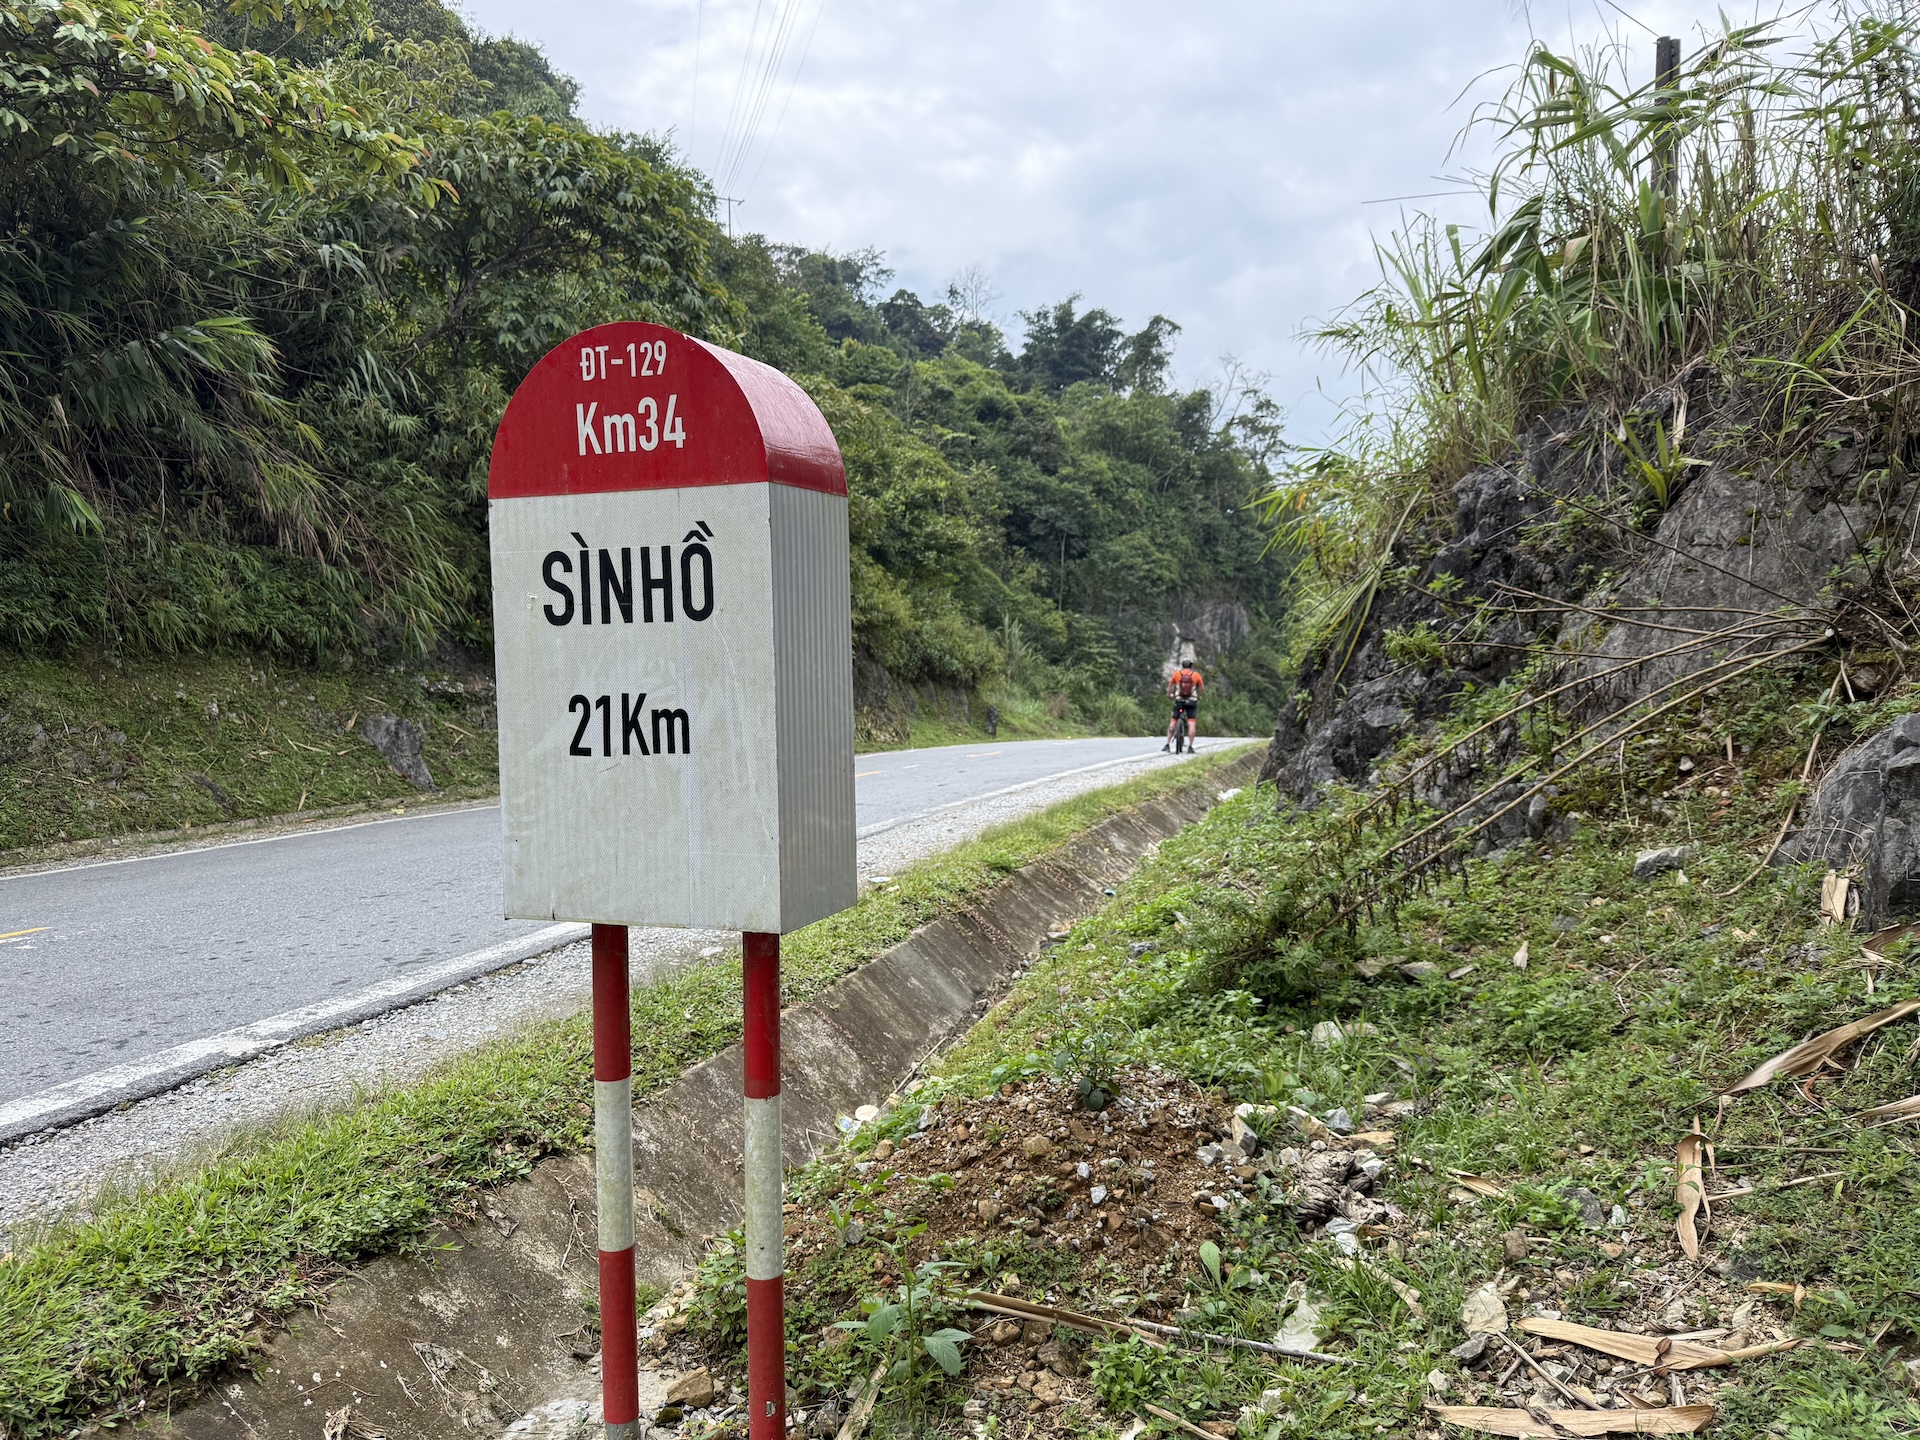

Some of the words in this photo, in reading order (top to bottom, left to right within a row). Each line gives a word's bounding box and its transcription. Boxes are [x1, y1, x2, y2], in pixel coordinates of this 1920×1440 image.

[579, 339, 667, 381] ĐT-129
[575, 393, 687, 457] Km34
[542, 520, 715, 627] SÌNHỒ
[568, 692, 691, 757] 21Km
